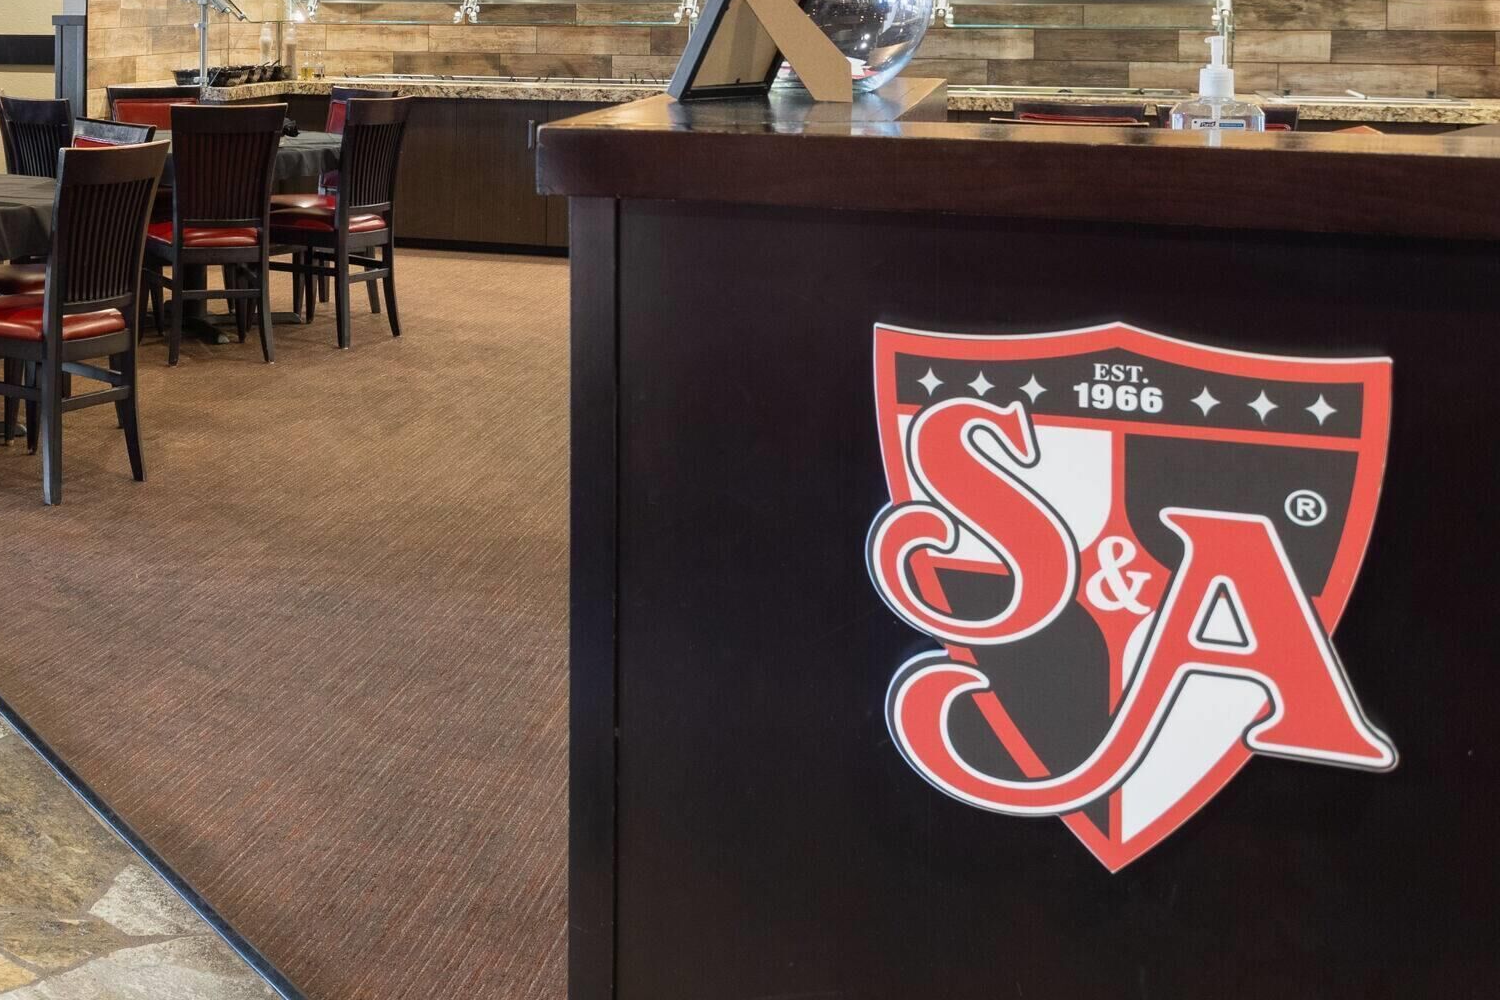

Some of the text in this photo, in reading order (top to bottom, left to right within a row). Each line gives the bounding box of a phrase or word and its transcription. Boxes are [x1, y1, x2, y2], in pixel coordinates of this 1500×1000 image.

[1093, 363, 1149, 383] EST.
[1073, 382, 1163, 414] 1966
[865, 397, 1400, 818] S&A
